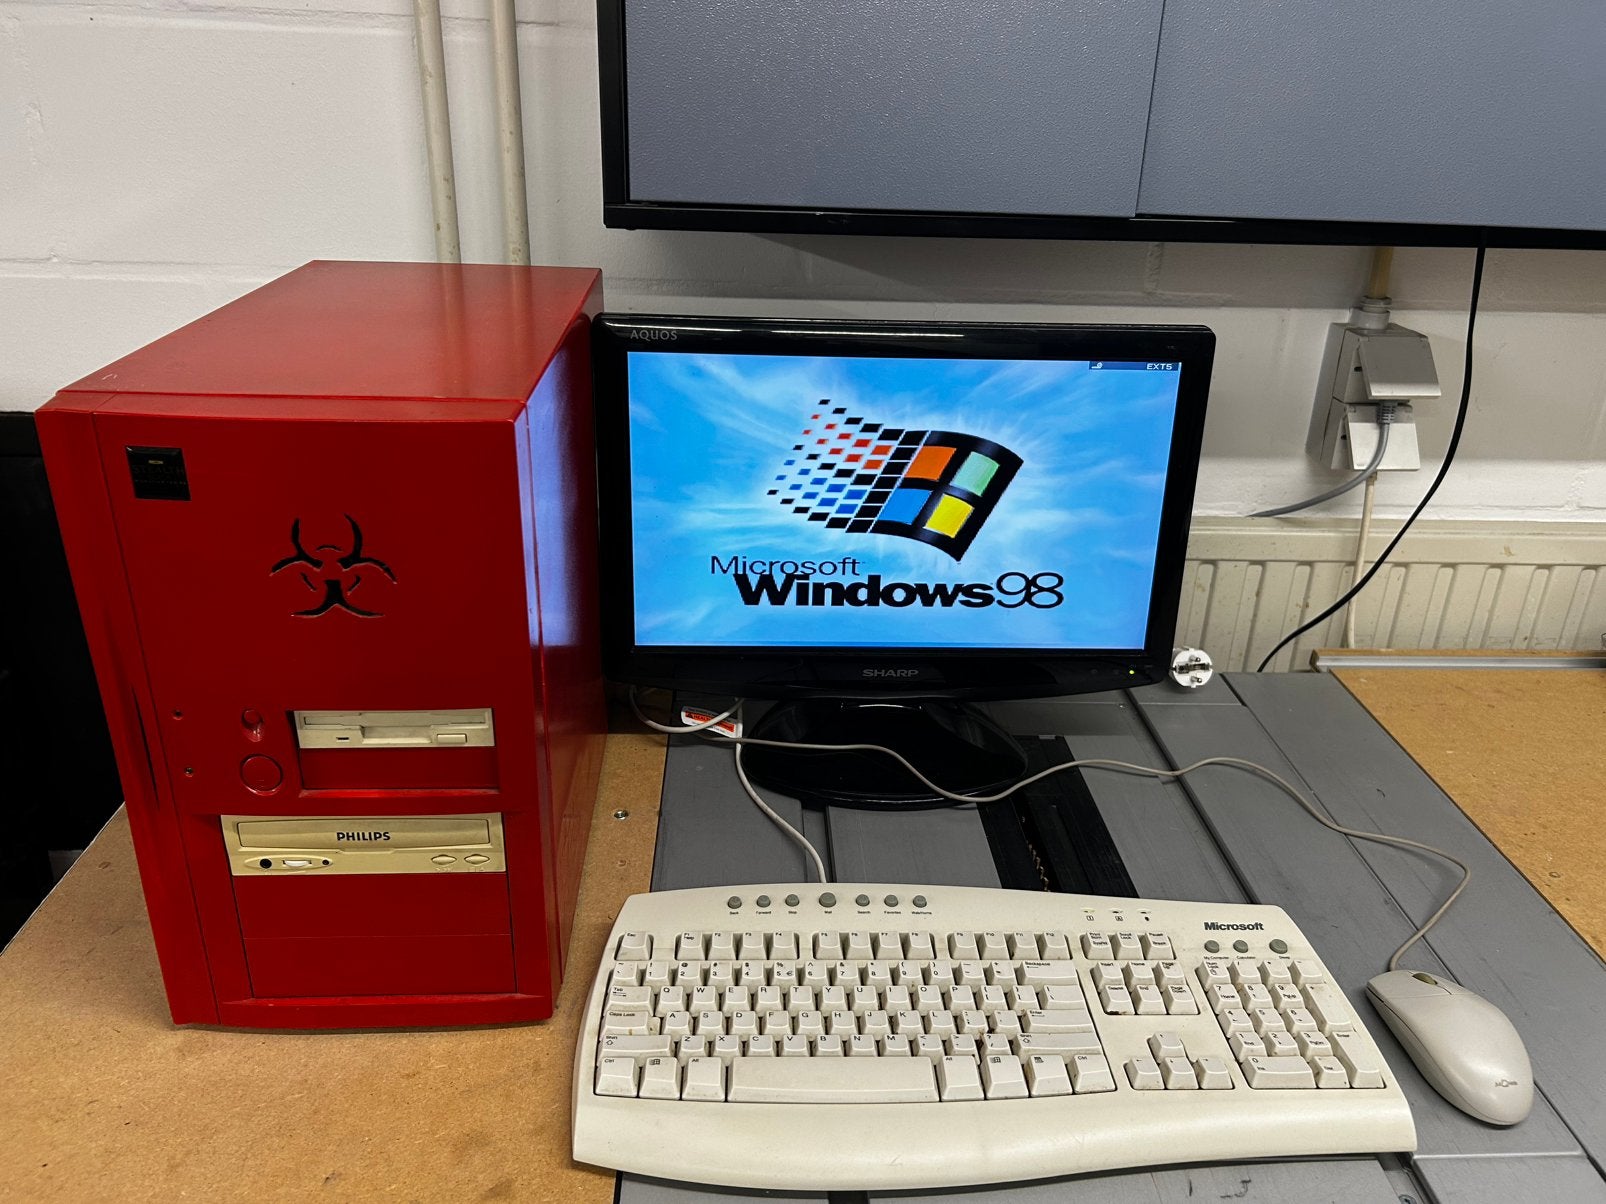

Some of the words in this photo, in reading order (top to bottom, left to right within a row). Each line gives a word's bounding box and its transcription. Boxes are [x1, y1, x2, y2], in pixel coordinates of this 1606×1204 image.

[630, 329, 678, 342] AQUOS
[710, 555, 862, 577] Microsoft
[861, 668, 920, 678] SHARP
[336, 832, 392, 842] PHILIPS
[1203, 921, 1265, 931] Microsoft
